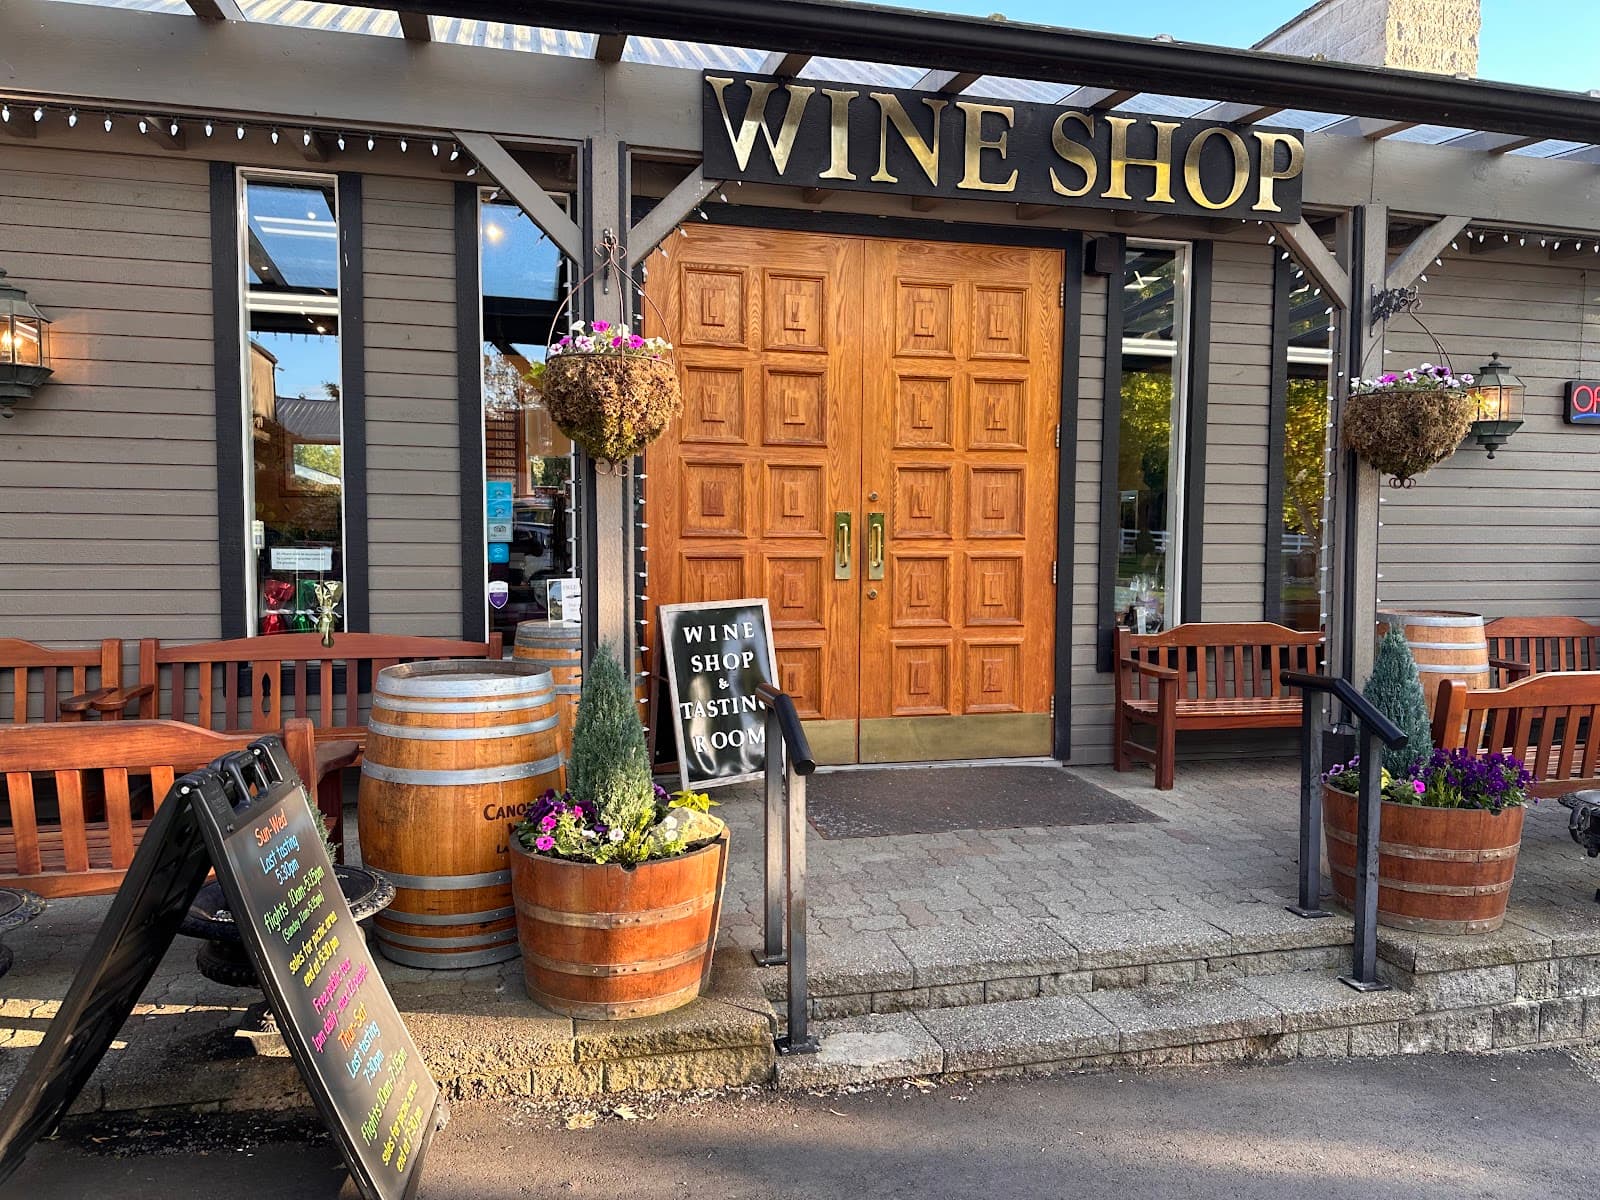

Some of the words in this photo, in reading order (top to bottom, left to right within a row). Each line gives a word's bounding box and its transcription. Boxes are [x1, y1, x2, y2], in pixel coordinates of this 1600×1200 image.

[705, 75, 1019, 192] WINE
[1048, 110, 1305, 212] SHOP
[683, 622, 755, 644] WINE
[691, 651, 754, 673] SHOP
[718, 677, 730, 690] &
[680, 694, 766, 720] TASTIN
[692, 726, 766, 753] ROOM
[254, 808, 288, 847] Sun-Wed
[260, 849, 278, 875] Last
[276, 834, 300, 861] tasting
[275, 858, 300, 885] 5:30pm
[264, 901, 289, 934] flights
[288, 865, 325, 908] 10am-5:15pm
[289, 950, 305, 975] sales
[302, 939, 313, 958] for
[312, 922, 328, 951] picnic
[325, 910, 339, 930] area
[303, 963, 316, 987] end
[313, 957, 321, 975] at
[317, 941, 332, 966] 5:30
[329, 935, 340, 956] pm
[312, 991, 329, 1015] Free
[325, 970, 342, 1001] public
[311, 1030, 327, 1053] 1pm
[324, 1010, 339, 1034] daily
[338, 1001, 367, 1051] Thur-Sat
[346, 1048, 362, 1079] Last
[358, 1020, 381, 1057] tasting
[363, 1048, 385, 1086] 7:30pm
[361, 1103, 382, 1147] flights
[376, 1046, 408, 1109] 10am-7:15pm
[382, 1135, 395, 1166] sales
[389, 1120, 400, 1142] for
[407, 1079, 418, 1102] area
[396, 1145, 407, 1173] end
